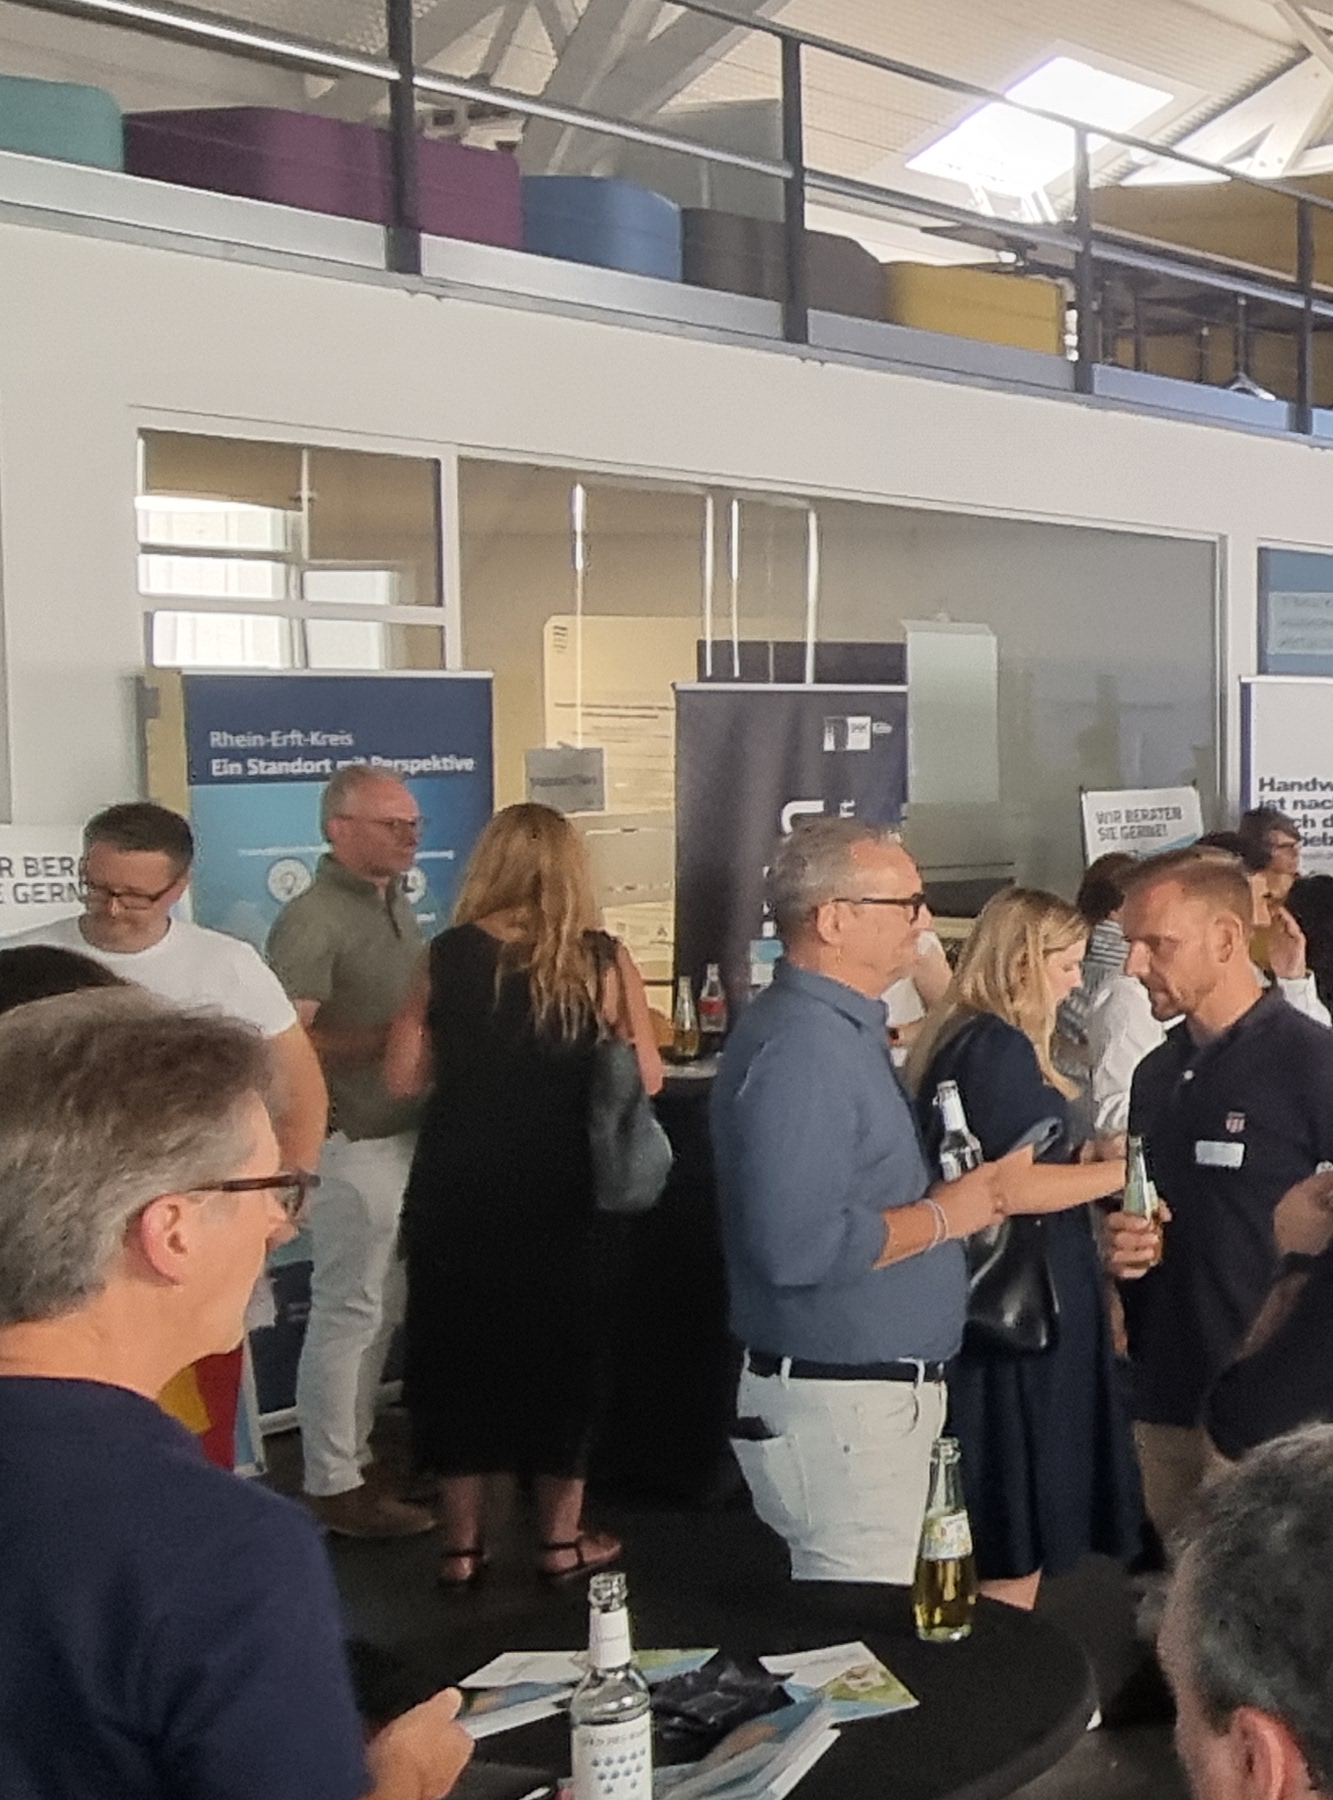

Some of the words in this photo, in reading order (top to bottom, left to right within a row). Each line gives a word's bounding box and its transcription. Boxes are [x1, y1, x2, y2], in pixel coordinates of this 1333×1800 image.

[209, 730, 354, 748] Rhein-Erft-Kreis
[211, 758, 242, 776] Ein
[247, 757, 333, 776] Standort
[370, 754, 475, 776] Perspektive
[13, 882, 83, 904] GERN
